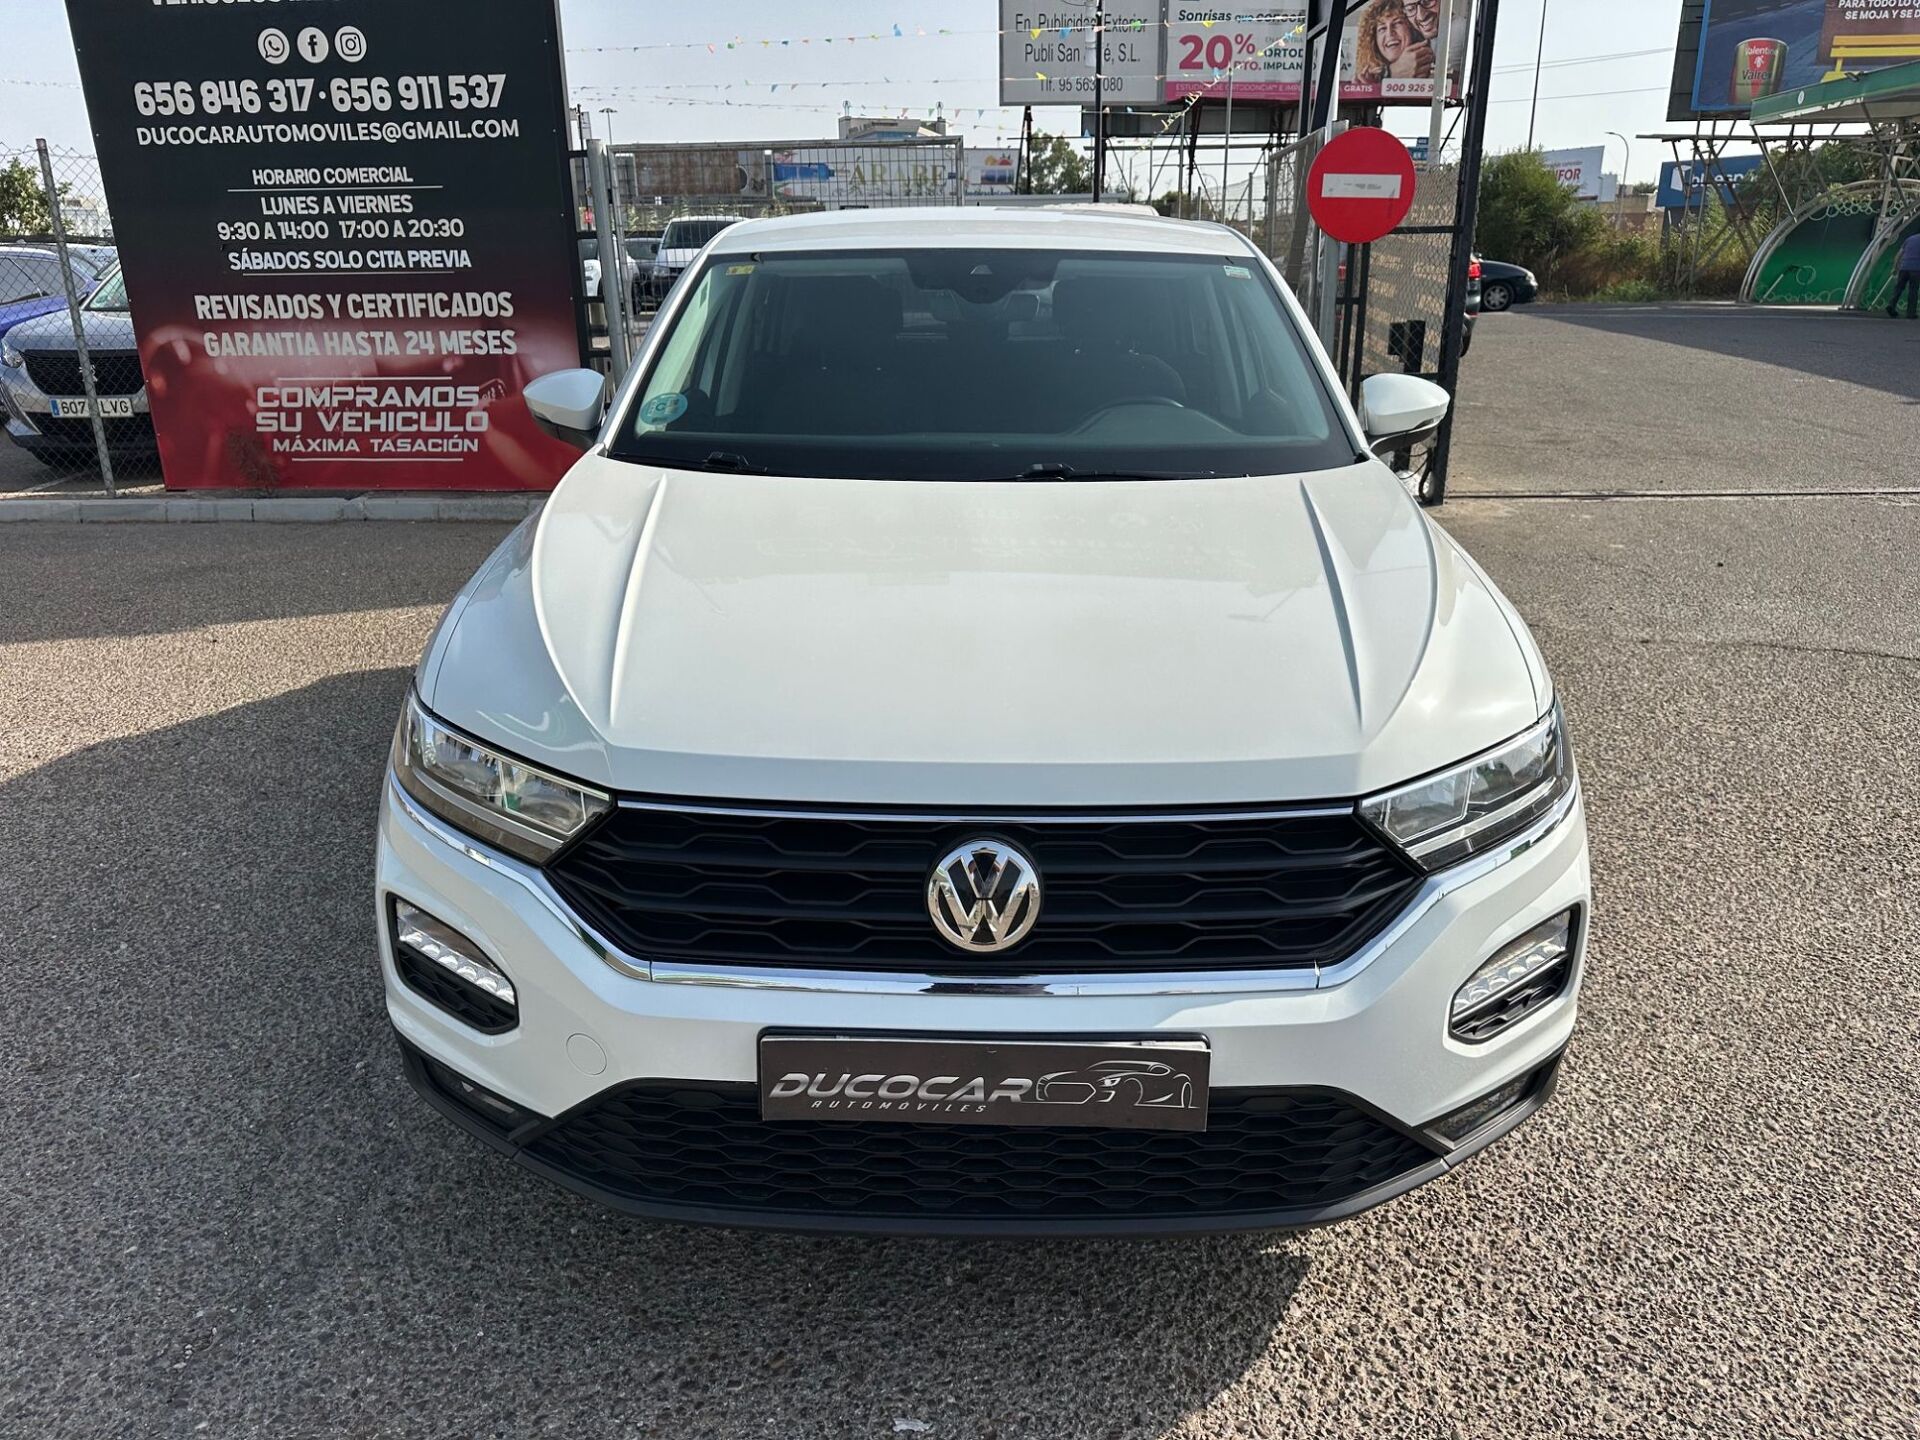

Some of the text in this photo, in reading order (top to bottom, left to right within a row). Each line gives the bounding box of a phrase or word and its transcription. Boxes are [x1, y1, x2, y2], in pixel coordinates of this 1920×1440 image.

[1838, 0, 1866, 8] PARA
[1867, 0, 1897, 8] TODO
[1015, 13, 1031, 33] En
[1178, 9, 1232, 22] Sonrisas
[1844, 10, 1858, 20] SE
[1859, 10, 1889, 20] MOJA
[1891, 10, 1899, 19] Y
[1900, 9, 1913, 19] SE
[1024, 43, 1054, 63] Publi
[1057, 43, 1080, 63] San
[1118, 43, 1141, 62] S.L.
[134, 81, 196, 116] 656
[199, 79, 262, 115] 846
[397, 76, 444, 111] 911
[448, 74, 507, 110] 537
[1059, 78, 1073, 92] 95
[1343, 84, 1373, 93] GRATIS
[1385, 83, 1406, 92] 900
[1407, 83, 1426, 92] 926
[136, 119, 520, 146] DUCOCARAUTOMOVILES@GMAIL.COM
[252, 166, 414, 186] HORARIO COMERCIAL
[260, 194, 414, 216] LUNES A VIERNES
[217, 218, 465, 241] 9:30 A 14:00 17:00 A 20:30
[228, 247, 472, 271] SÁBADOS SOLO CITA PREVIA
[194, 291, 514, 320] REVISADOS Y CERTIFICADOS
[203, 329, 518, 357] GARANTIA HASTA 24 MESES
[256, 385, 480, 408] COMPRAMOS
[61, 400, 129, 415] 607 LVG
[255, 410, 489, 433] SU VEHICULO
[272, 434, 479, 453] MÁXIMA TASACIÓN
[768, 1072, 1033, 1103] DUCOCAR
